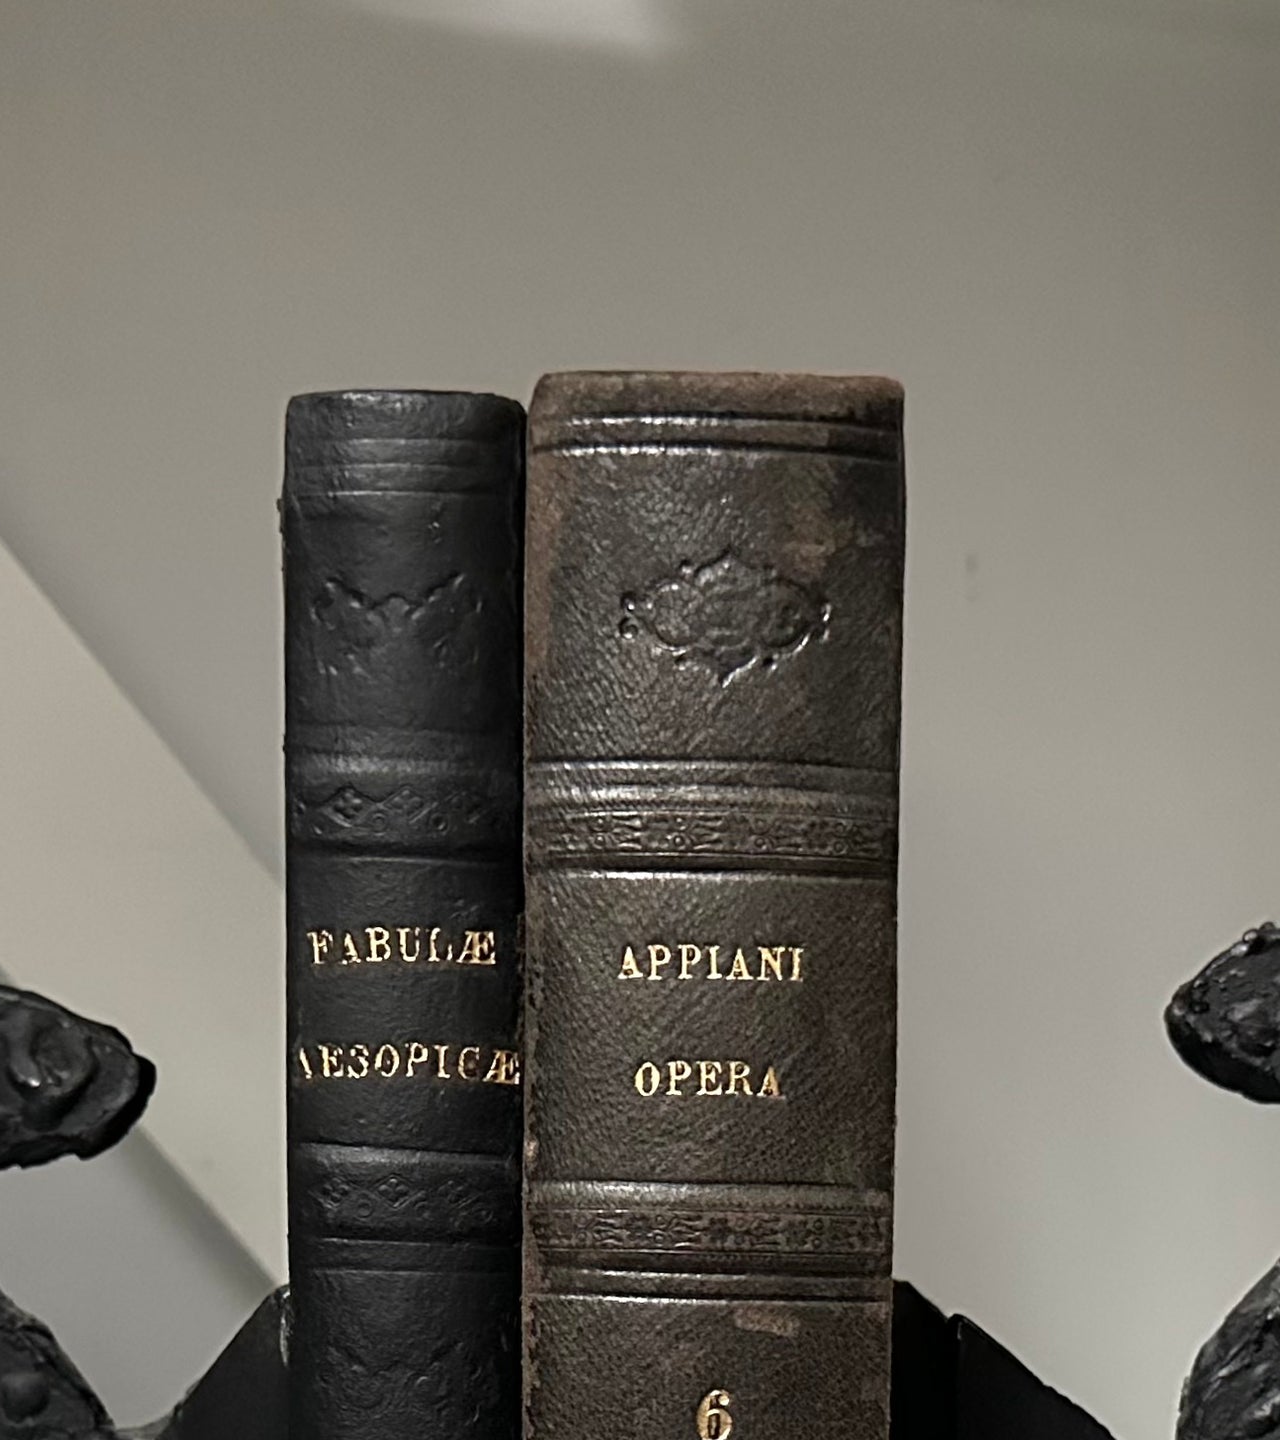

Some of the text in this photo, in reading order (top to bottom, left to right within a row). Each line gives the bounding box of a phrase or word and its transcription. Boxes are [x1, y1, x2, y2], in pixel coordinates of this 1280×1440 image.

[306, 926, 497, 965] FABULÆ
[617, 943, 805, 982] APPIANI
[634, 1060, 787, 1099] OPERA
